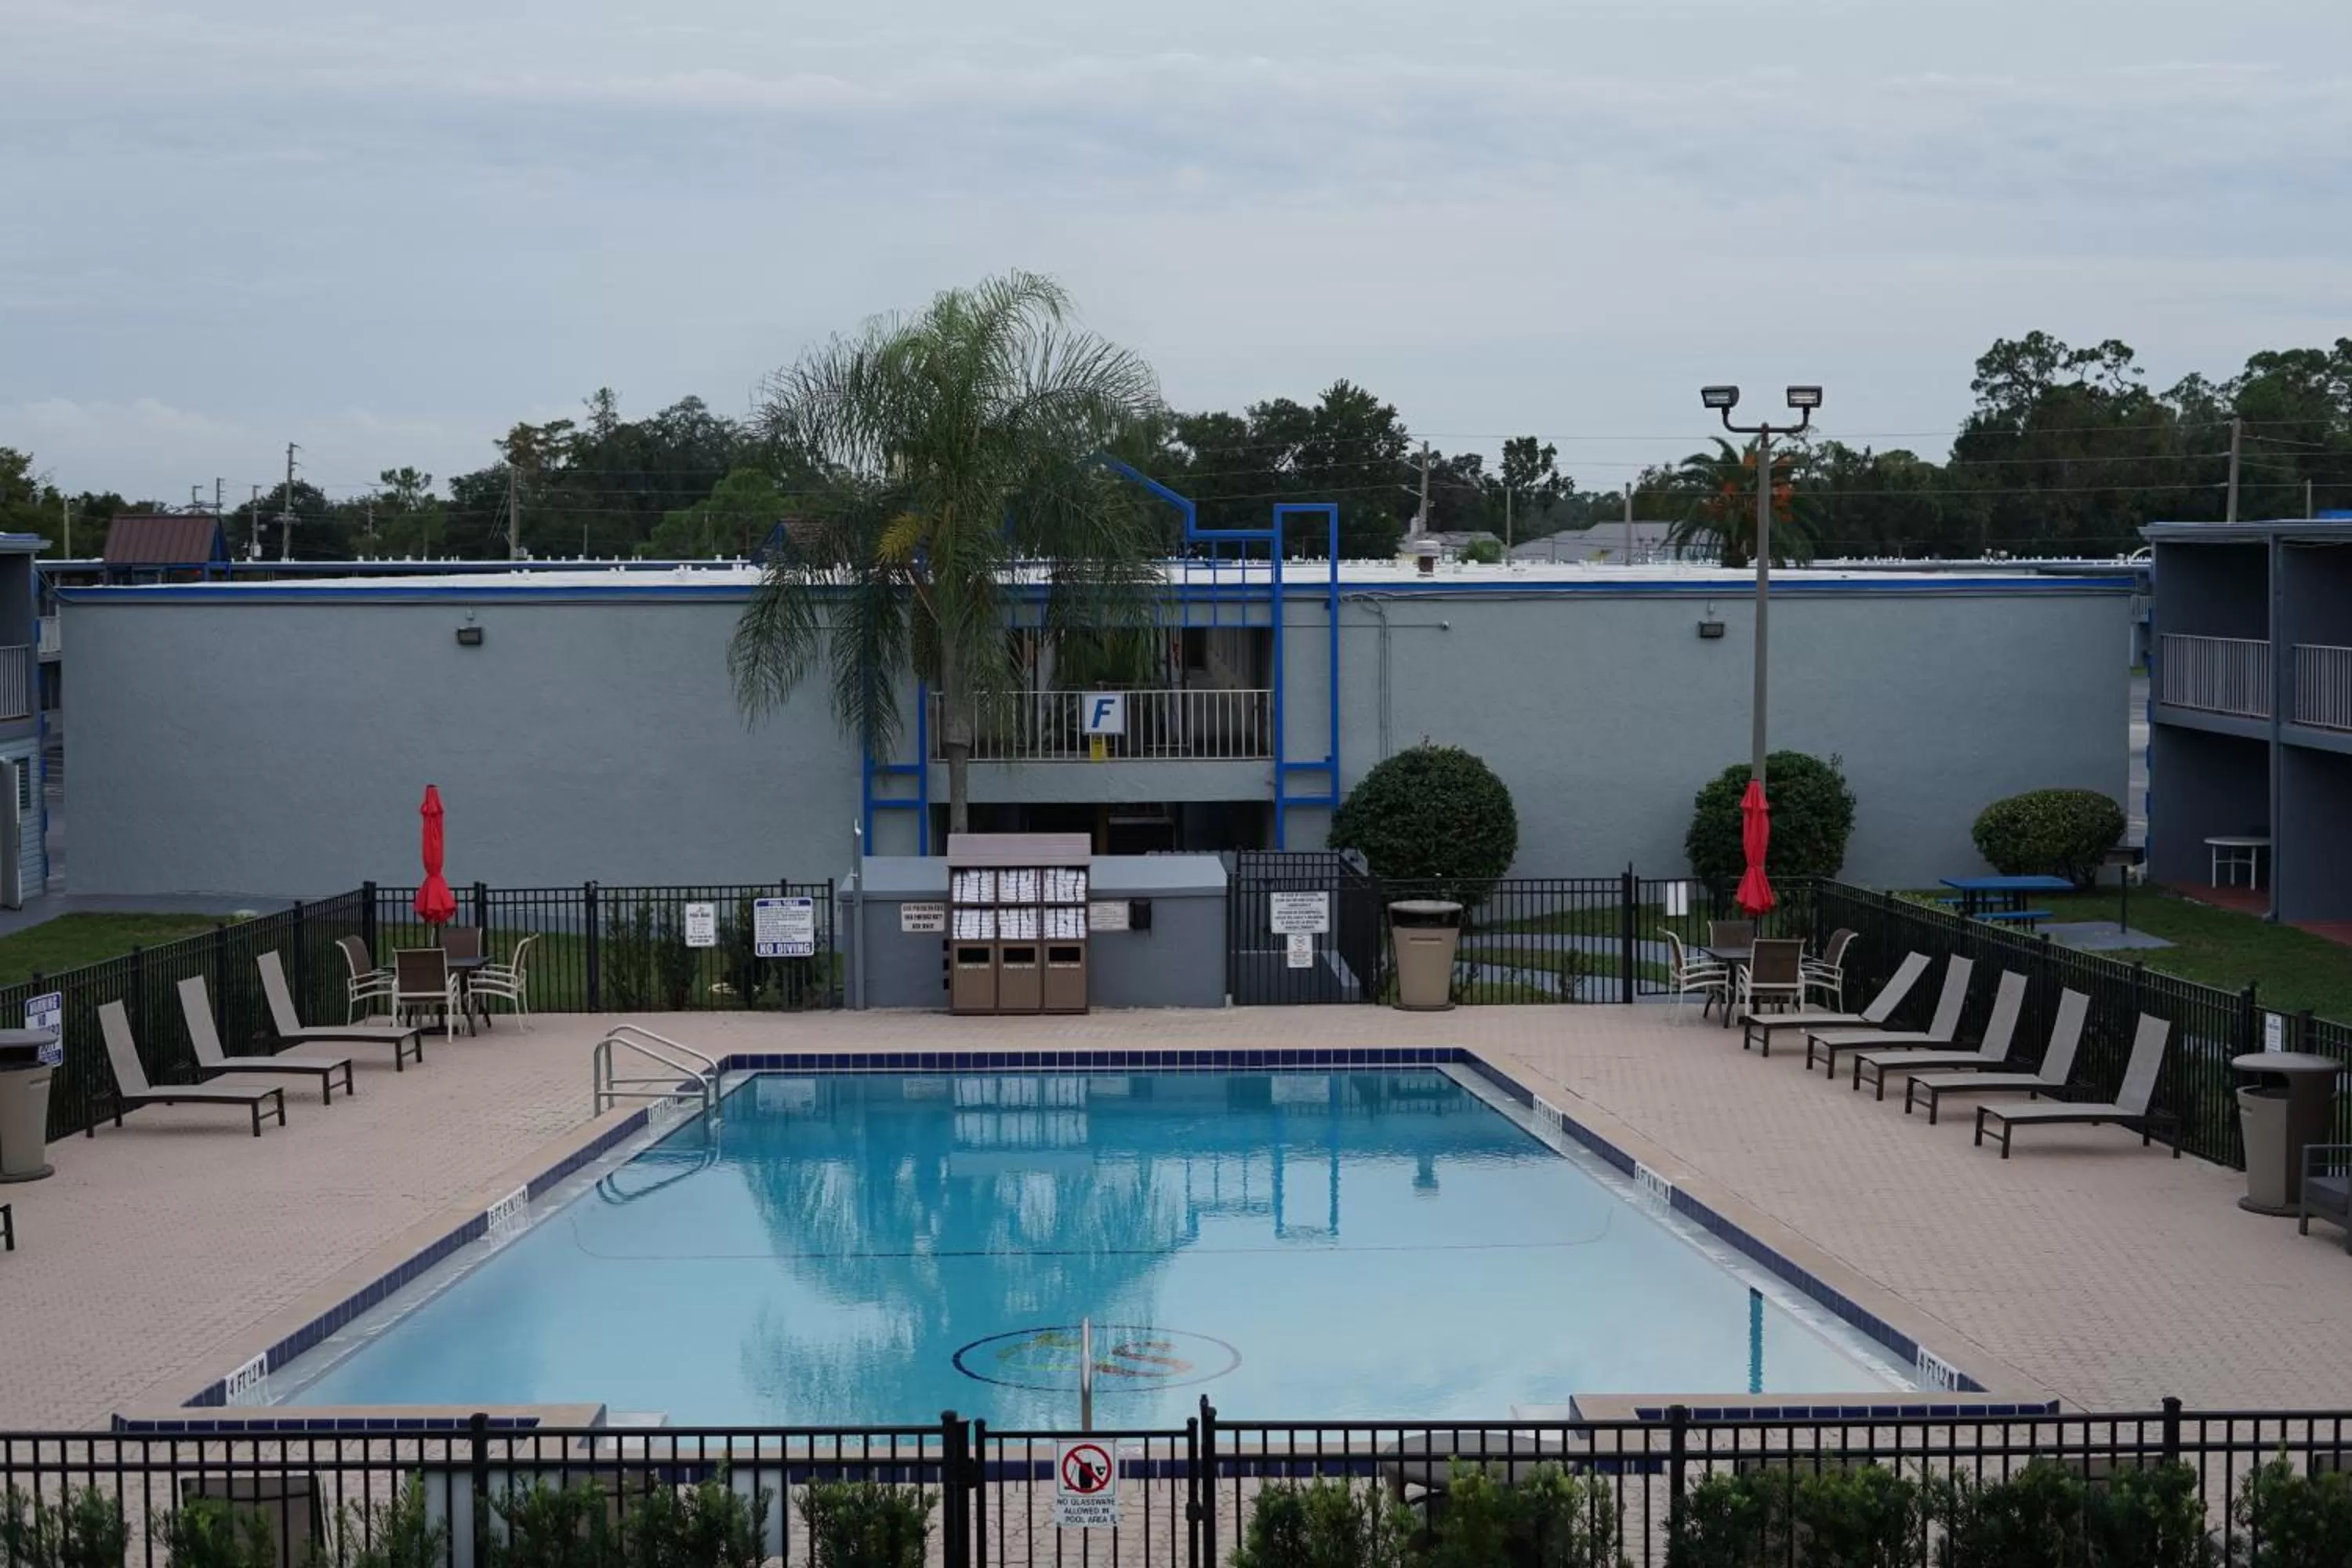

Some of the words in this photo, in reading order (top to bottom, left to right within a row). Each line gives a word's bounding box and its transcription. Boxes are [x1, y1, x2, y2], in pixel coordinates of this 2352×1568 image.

[1091, 699, 1115, 728] F
[760, 943, 774, 954] NO
[777, 943, 811, 954] DIVING
